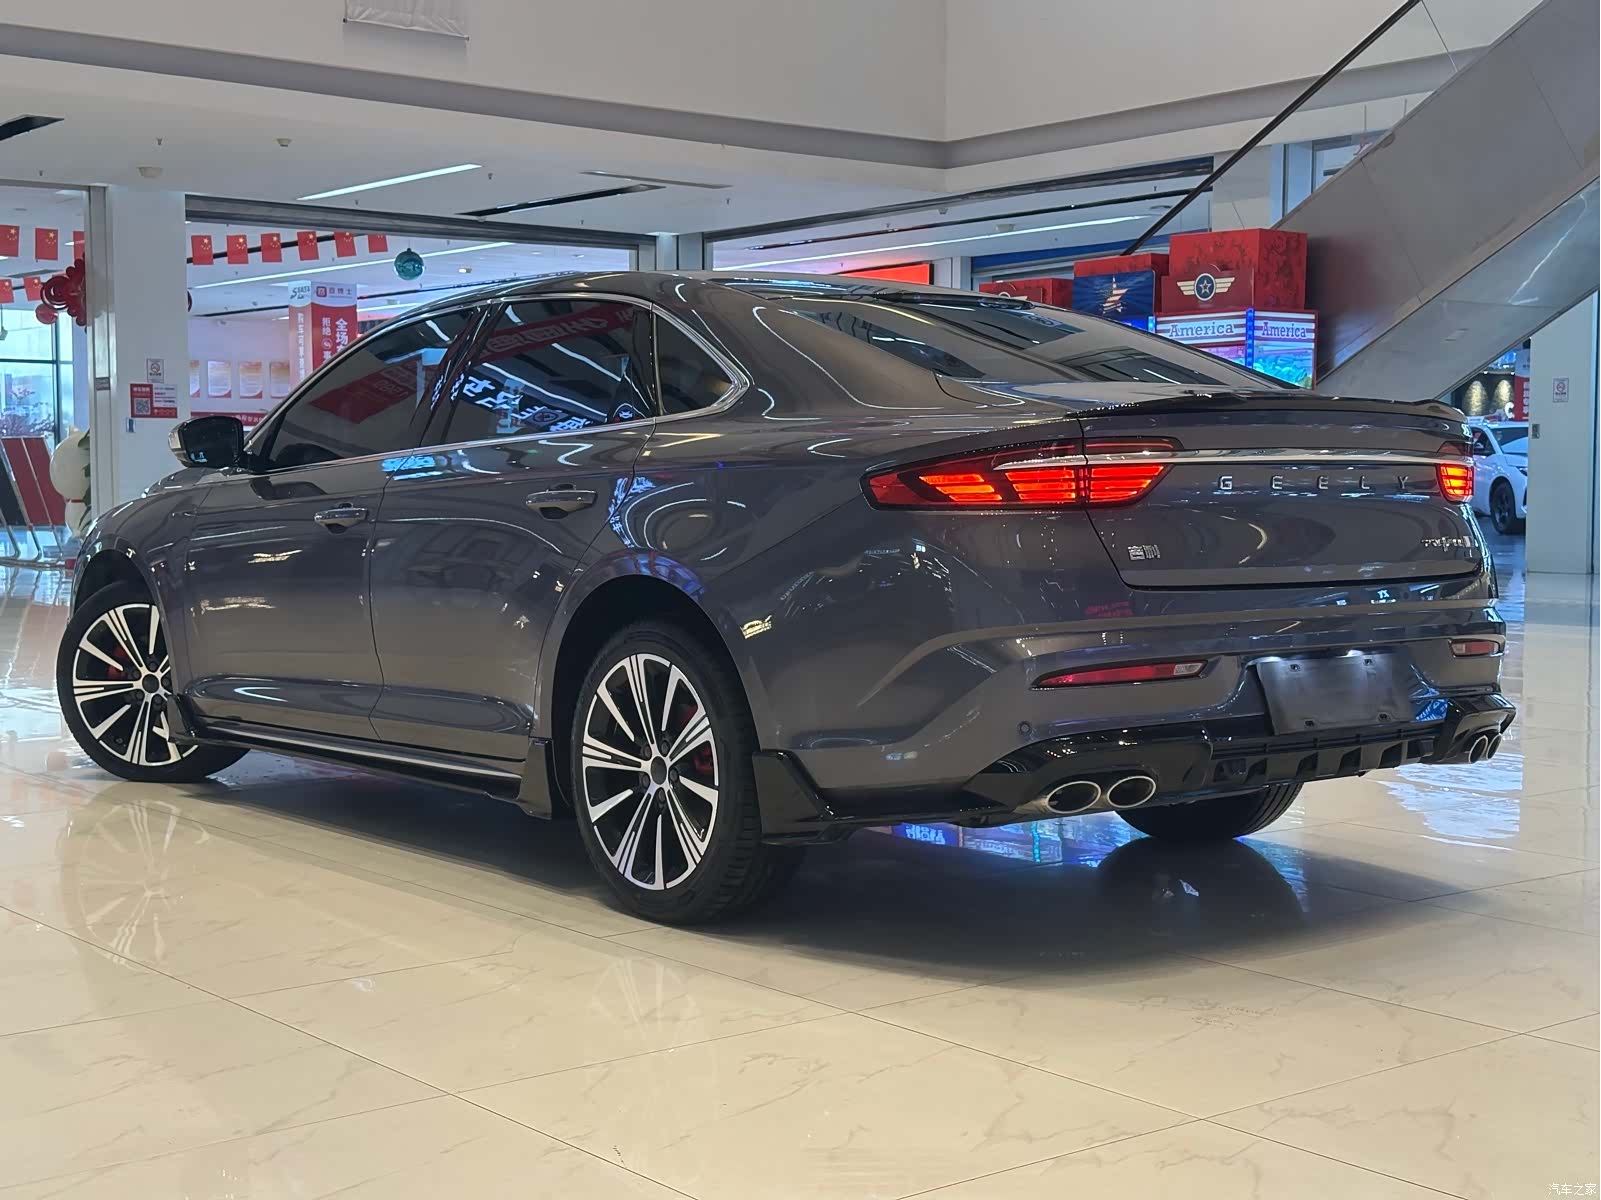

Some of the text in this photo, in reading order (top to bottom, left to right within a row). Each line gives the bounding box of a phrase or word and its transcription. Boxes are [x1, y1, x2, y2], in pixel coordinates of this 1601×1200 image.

[1169, 322, 1234, 337] America
[1262, 322, 1307, 338] America
[1219, 475, 1409, 490] GEELY
